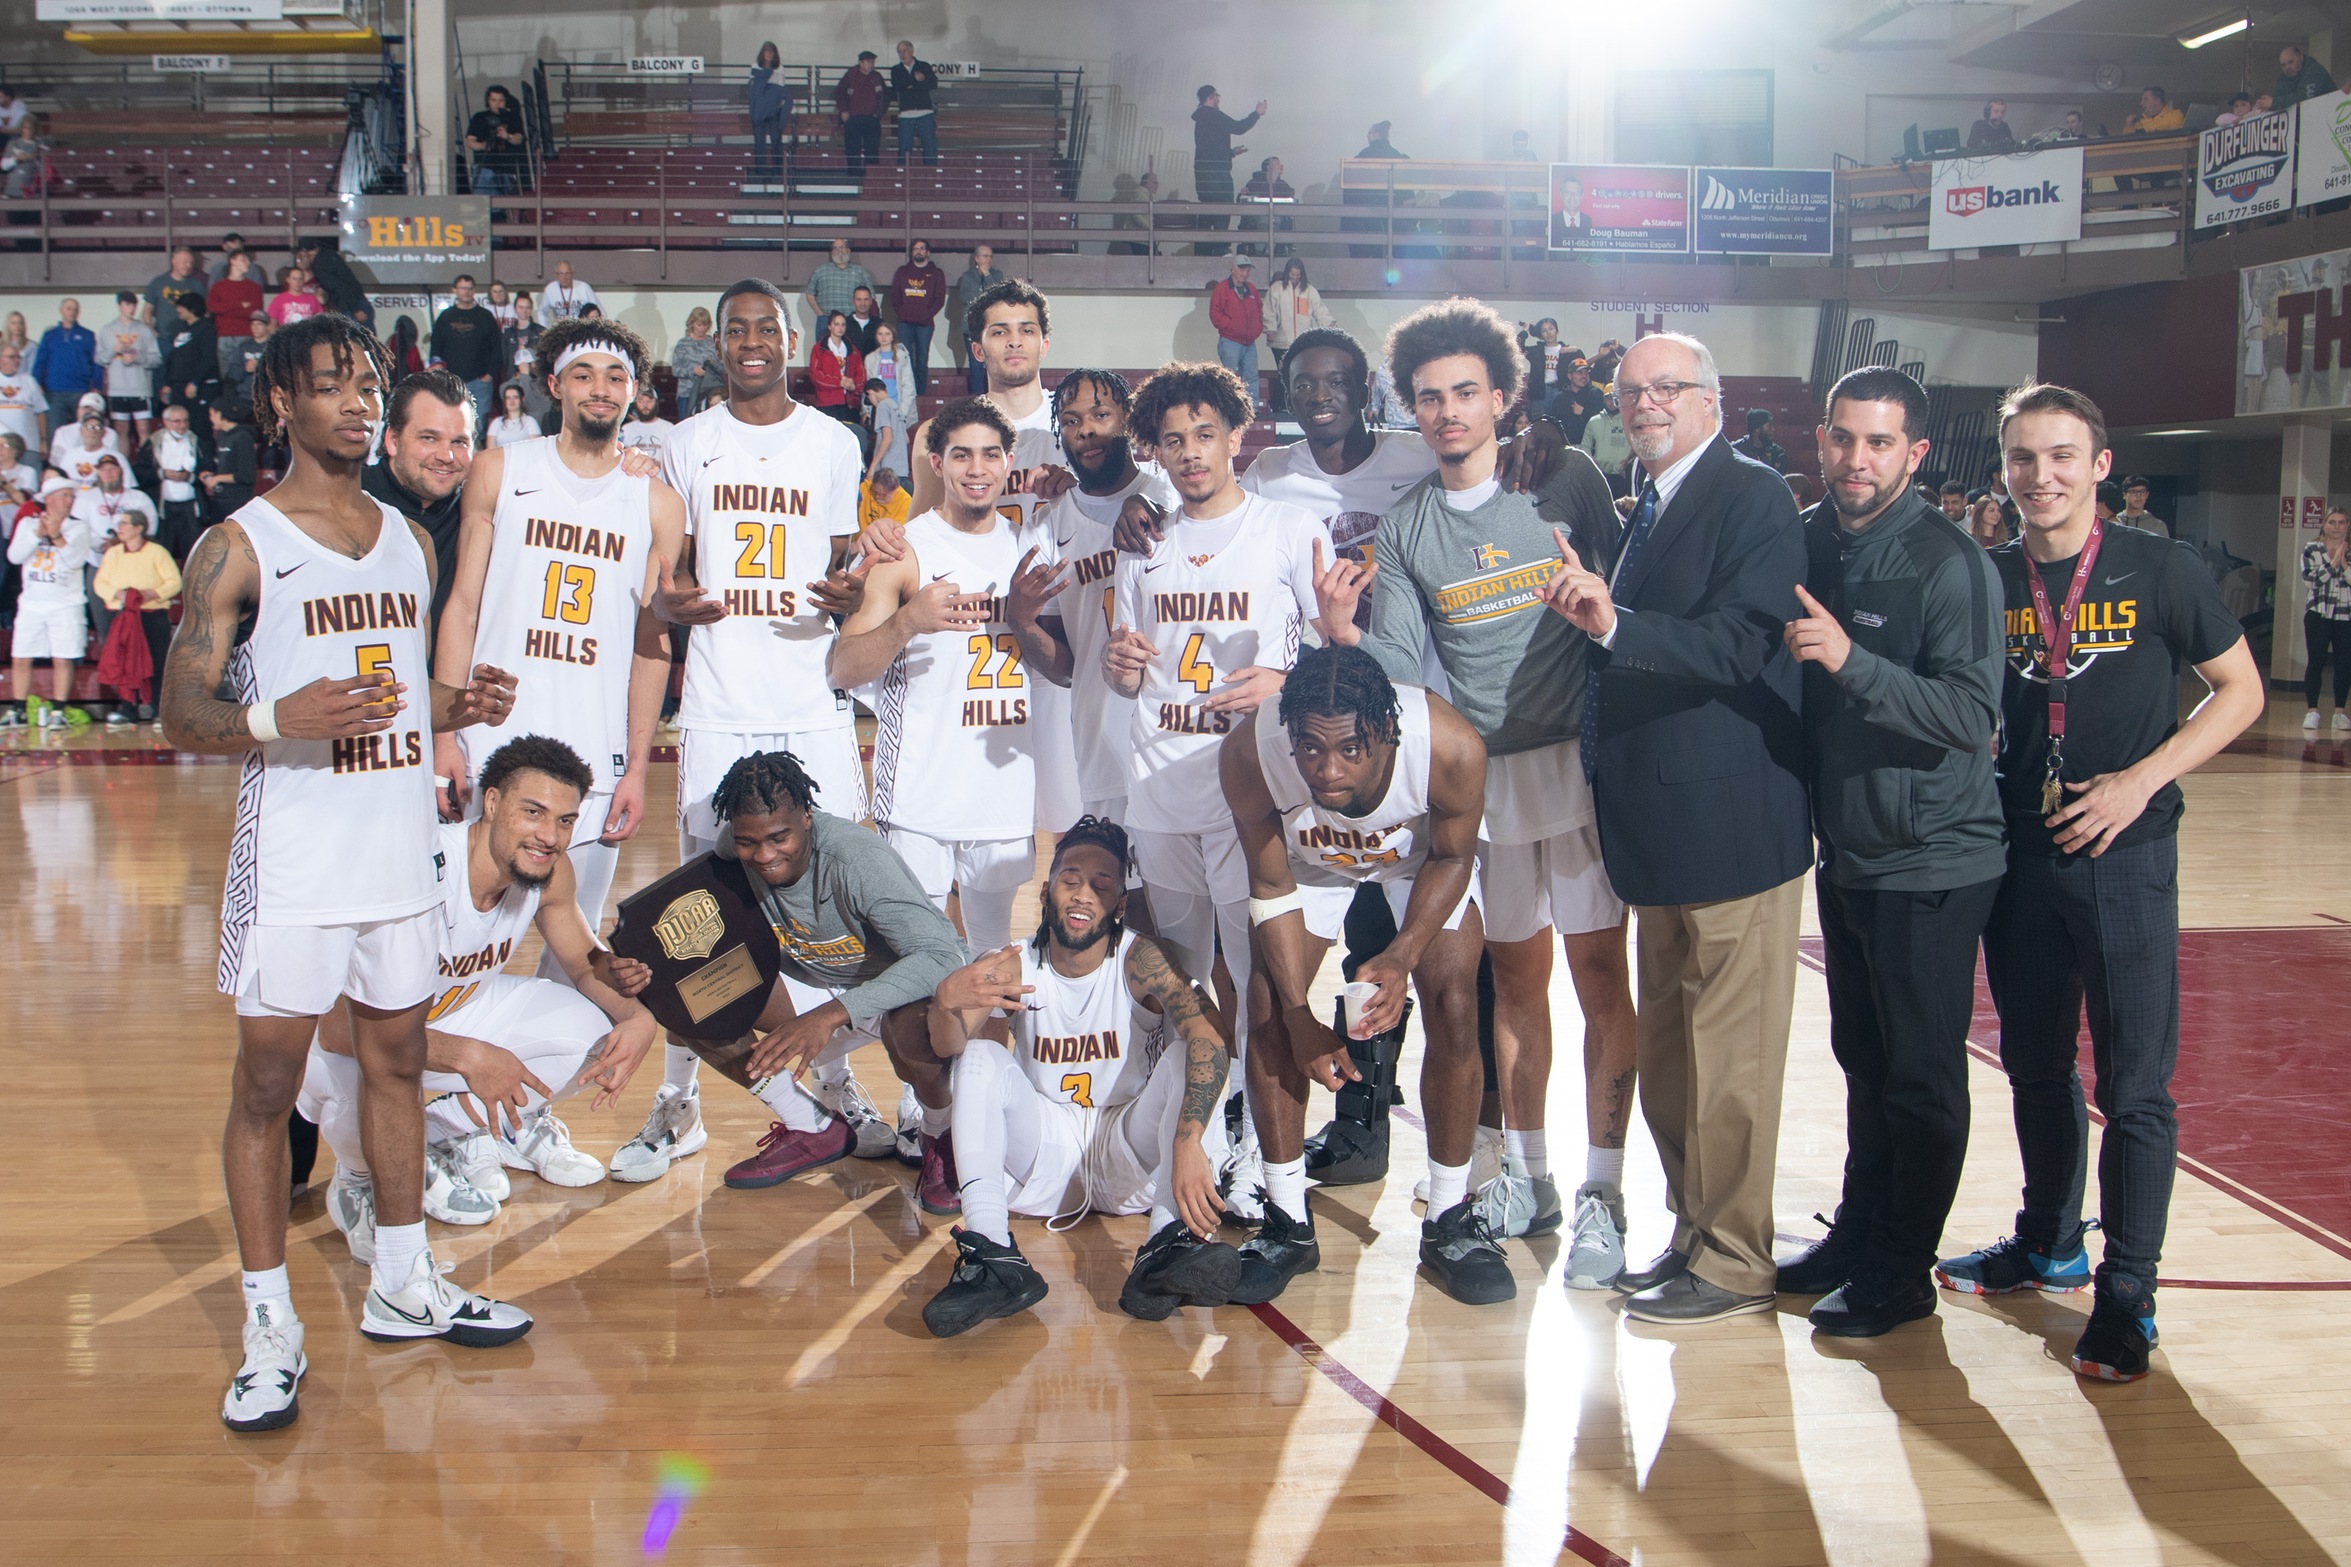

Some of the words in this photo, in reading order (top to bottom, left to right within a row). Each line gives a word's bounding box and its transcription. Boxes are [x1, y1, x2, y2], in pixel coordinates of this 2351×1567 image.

[157, 57, 210, 69] BALCONY
[217, 57, 226, 69] F
[631, 59, 684, 71] BALCONY
[690, 59, 700, 71] G
[931, 63, 961, 75] CONY
[967, 64, 977, 75] H
[2204, 110, 2289, 176] DURFLINGER
[2215, 163, 2275, 191] EXCAVATING
[1655, 190, 1684, 200] drivers.
[1738, 187, 1810, 205] Meridian
[2206, 198, 2280, 225] 641.777.9666
[367, 215, 465, 248] Hills
[1589, 228, 1613, 238] Doug
[1614, 228, 1649, 238] Bauman
[1615, 239, 1648, 249] Hablamos
[1649, 240, 1677, 249] Español
[1720, 231, 1808, 242] www.mymeridiancu.org
[345, 253, 400, 263] Download
[402, 253, 422, 263] the
[424, 253, 446, 264] App
[448, 253, 487, 264] Today!
[373, 297, 428, 309] SERVED
[1590, 301, 1648, 312] STUDENT
[1654, 302, 1710, 313] SECTION
[713, 484, 809, 517] INDIAN
[524, 517, 626, 563] INDIAN
[735, 521, 786, 580] 21
[29, 570, 57, 584] HILLS
[541, 560, 596, 626] 13
[724, 588, 796, 618] HILLS
[1154, 591, 1250, 624] INDIAN
[1437, 580, 1506, 614] INDIAN
[1466, 592, 1538, 617] BASKETBAL
[303, 592, 418, 637] INDIAN
[524, 628, 598, 667] HILLS
[966, 633, 1024, 691] 22
[1178, 632, 1215, 694] 4
[355, 643, 399, 720] 5
[961, 698, 1028, 727] HILLS
[1157, 702, 1232, 735] HILLS
[331, 730, 422, 775] HILLS
[652, 893, 720, 958] NJCAA
[814, 939, 866, 956] HILLS
[1032, 1030, 1121, 1065] INDIAN
